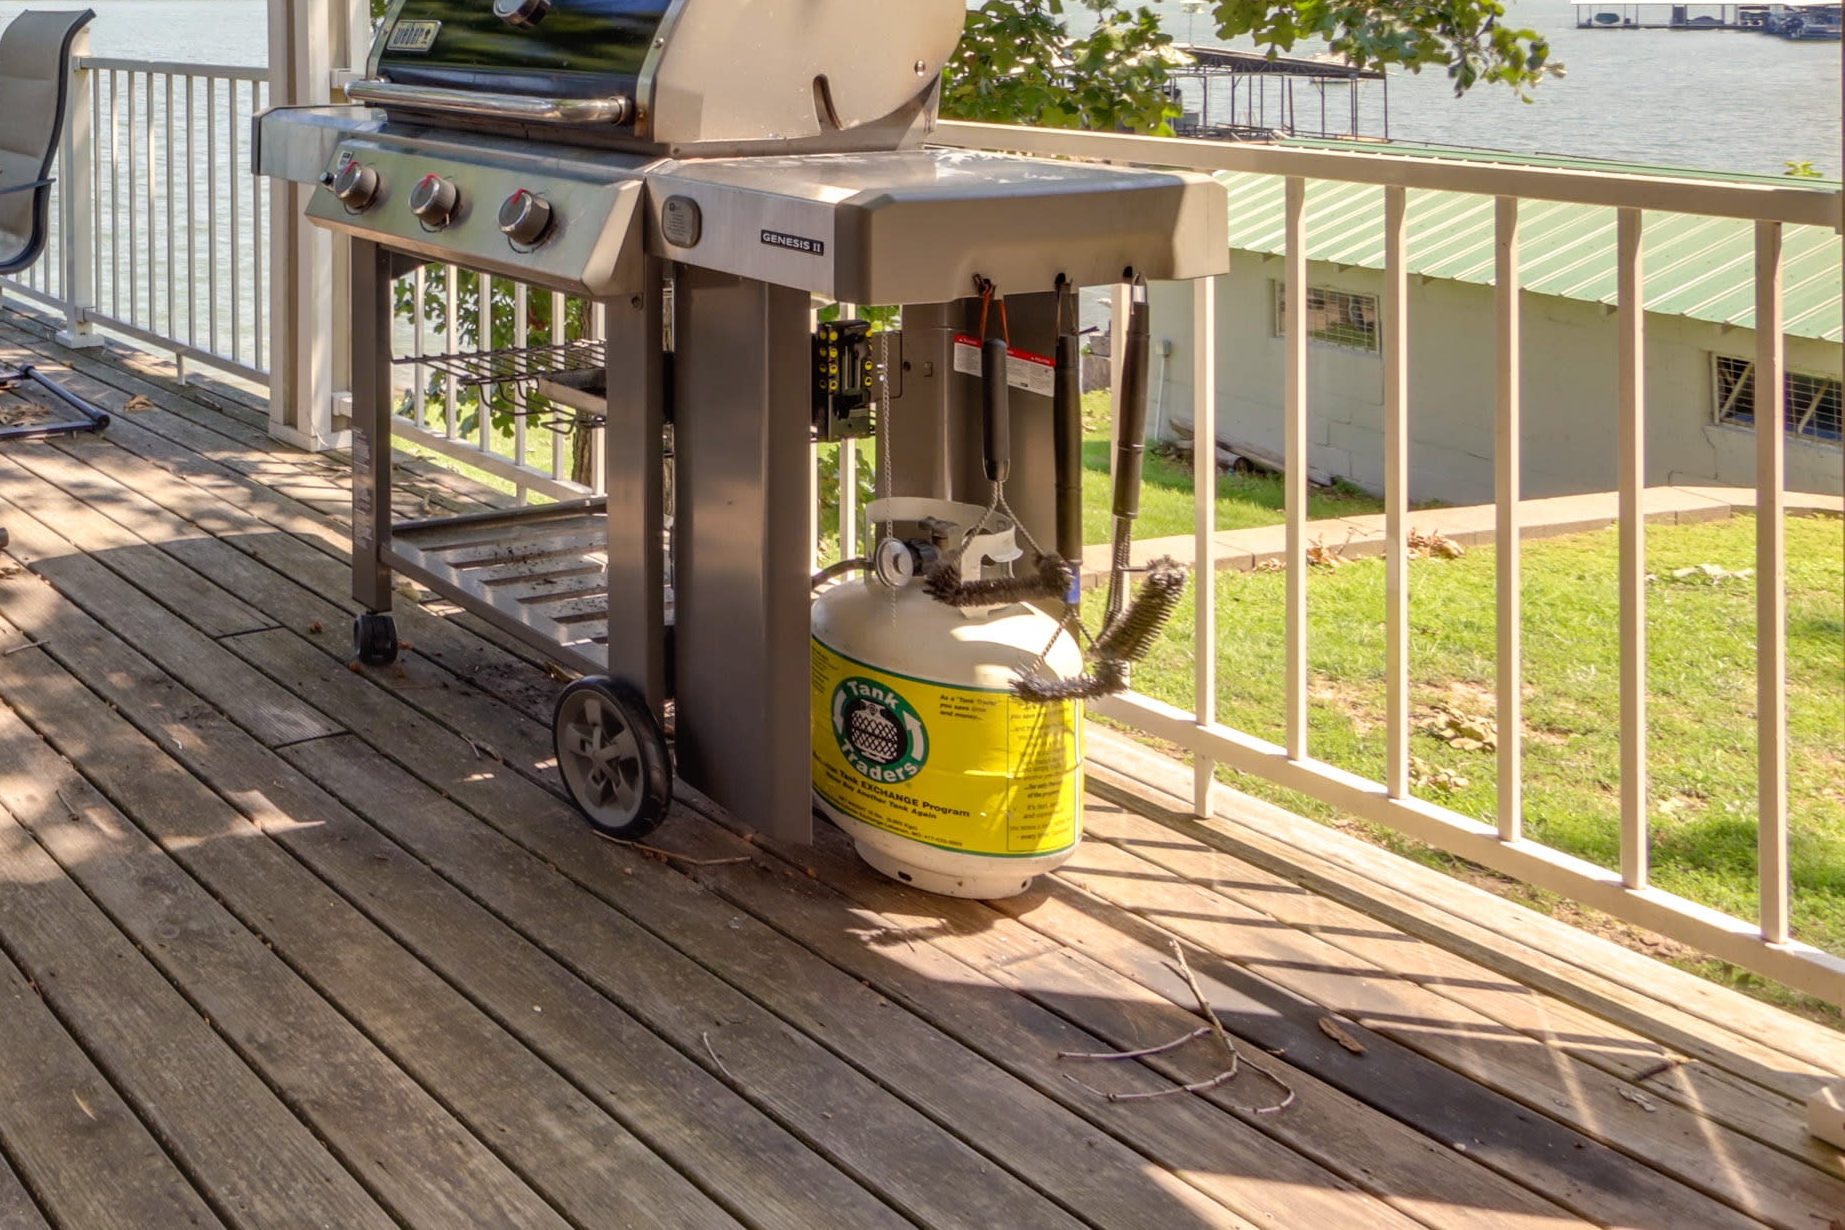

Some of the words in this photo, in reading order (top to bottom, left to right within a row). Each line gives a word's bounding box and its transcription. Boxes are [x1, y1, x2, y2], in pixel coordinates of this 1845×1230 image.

[813, 243, 821, 253] II
[847, 681, 899, 710] Tank
[842, 738, 918, 782] Traders
[857, 789, 886, 804] Another
[889, 801, 908, 812] Tank
[911, 808, 937, 819] Again
[861, 781, 919, 807] EXCHANGE
[922, 801, 970, 817] Program
